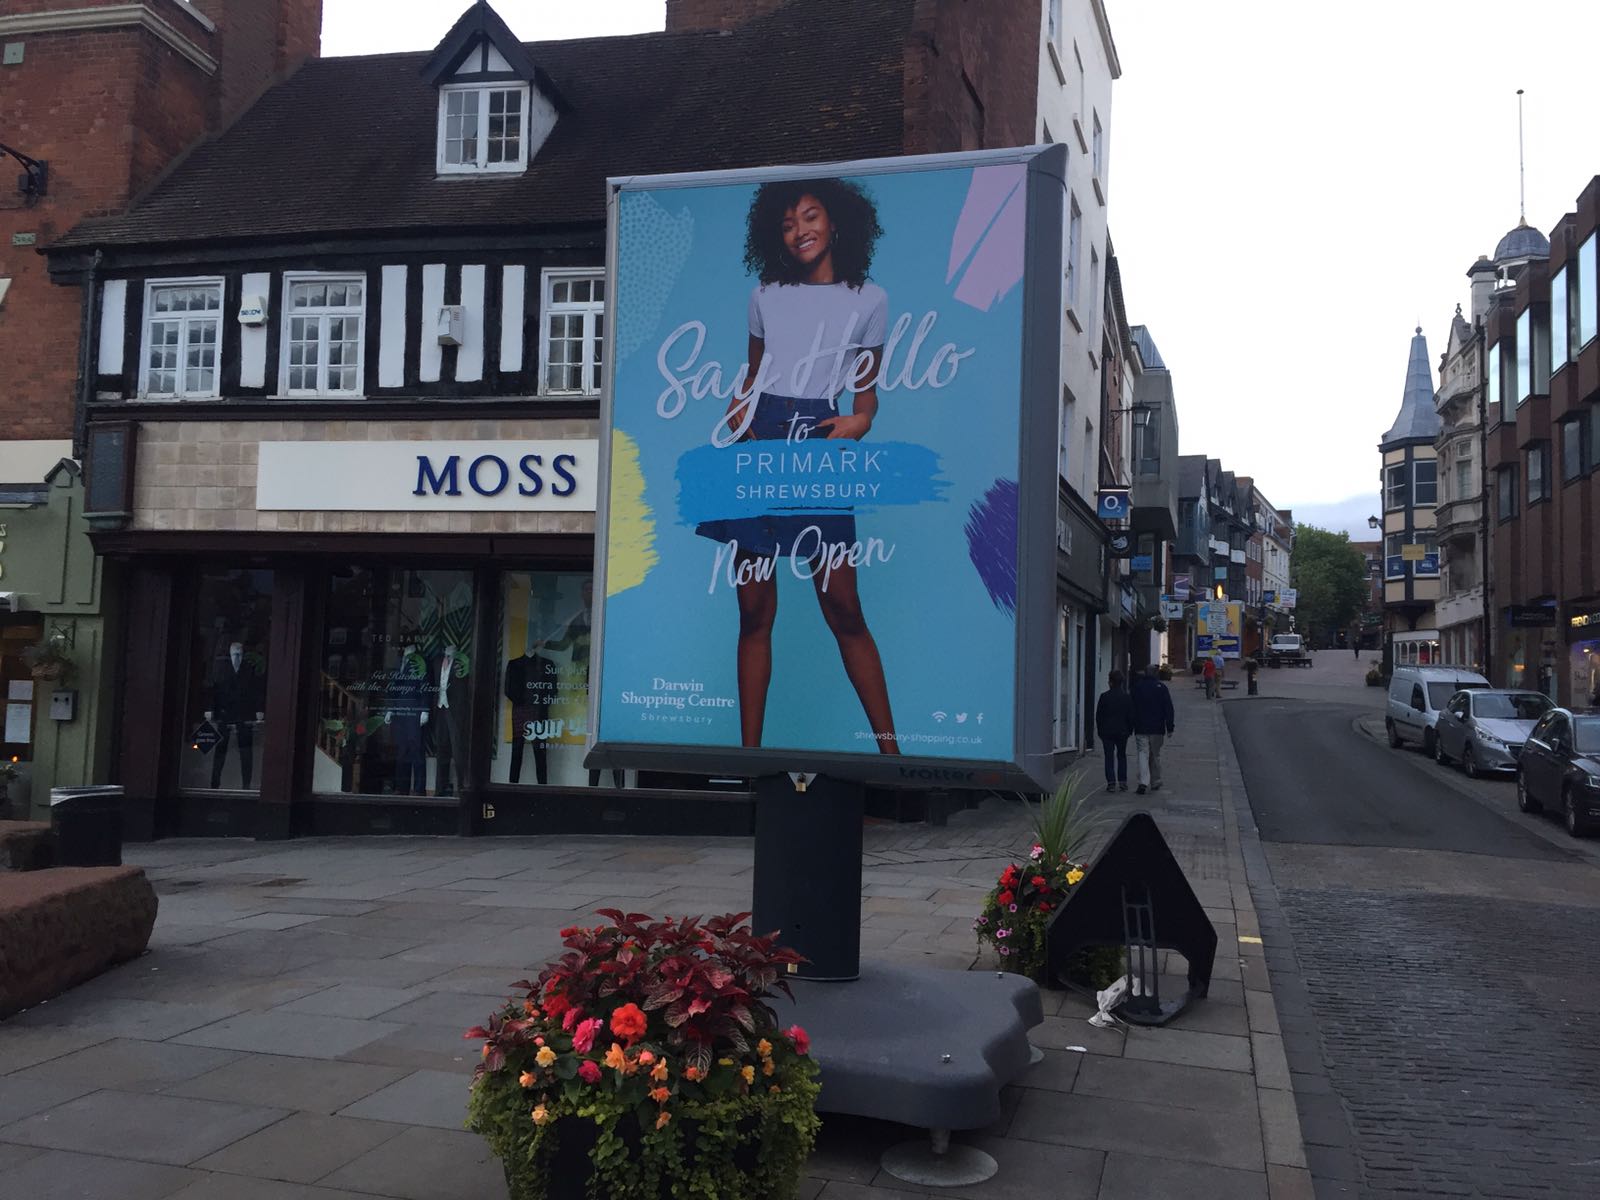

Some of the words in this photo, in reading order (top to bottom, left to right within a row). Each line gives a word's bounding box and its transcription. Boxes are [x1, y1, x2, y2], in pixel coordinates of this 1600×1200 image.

[656, 319, 780, 449] Say
[793, 310, 976, 410] Hello
[787, 411, 816, 447] to
[735, 449, 882, 475] PRIMARK
[412, 454, 577, 497] MOSS
[735, 483, 881, 500] SHREWSBURY
[708, 539, 781, 595] Now
[790, 524, 896, 593] Open
[526, 681, 553, 690] extra
[652, 677, 704, 692] Darwin
[532, 694, 540, 705] 2
[621, 691, 686, 710] Shopping
[688, 693, 735, 708] Centre
[641, 712, 713, 725] Shrewsbury
